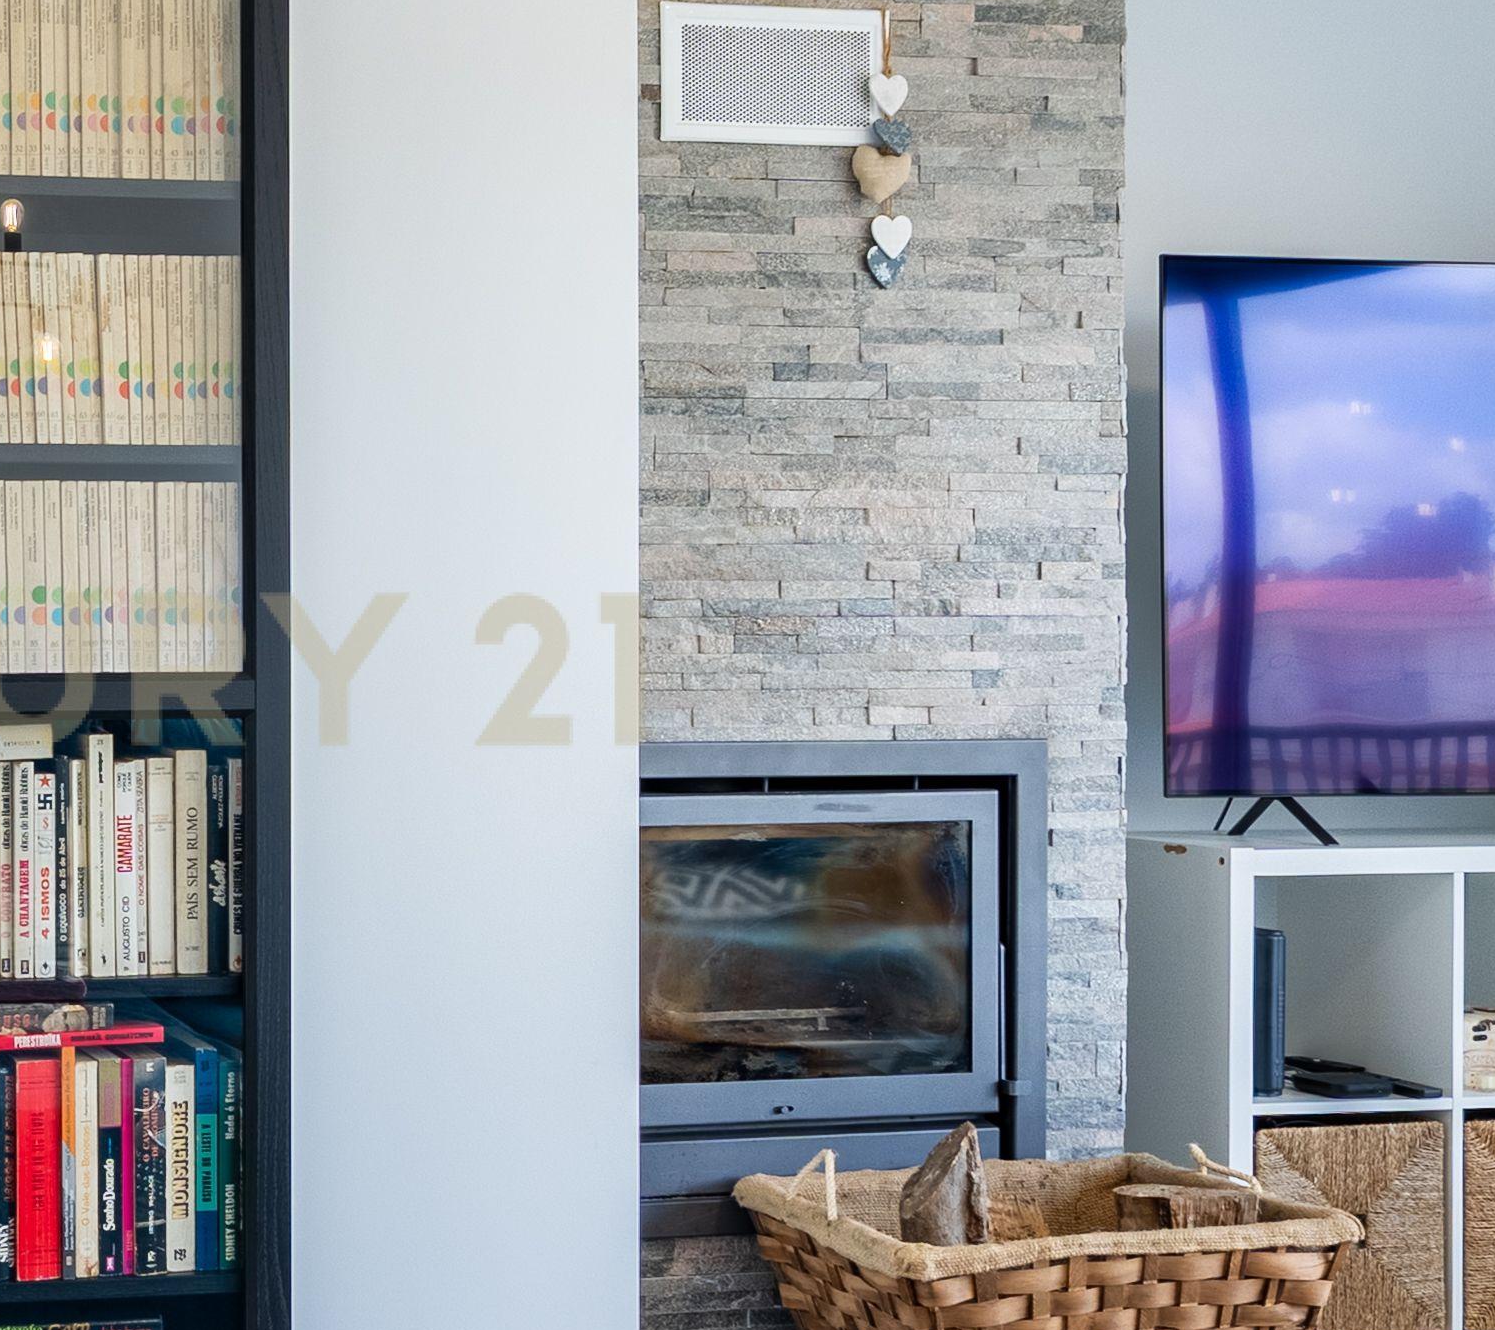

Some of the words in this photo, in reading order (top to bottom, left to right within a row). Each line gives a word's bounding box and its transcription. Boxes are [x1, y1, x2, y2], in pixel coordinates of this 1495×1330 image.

[117, 815, 133, 872] CAMARATE
[187, 807, 198, 849] RUMO
[19, 860, 29, 928] CHANTAGEM
[41, 867, 49, 921] ISMOS
[187, 857, 198, 887] SEM
[41, 929, 49, 939] 4
[172, 1101, 189, 1219] MONSIGNORE
